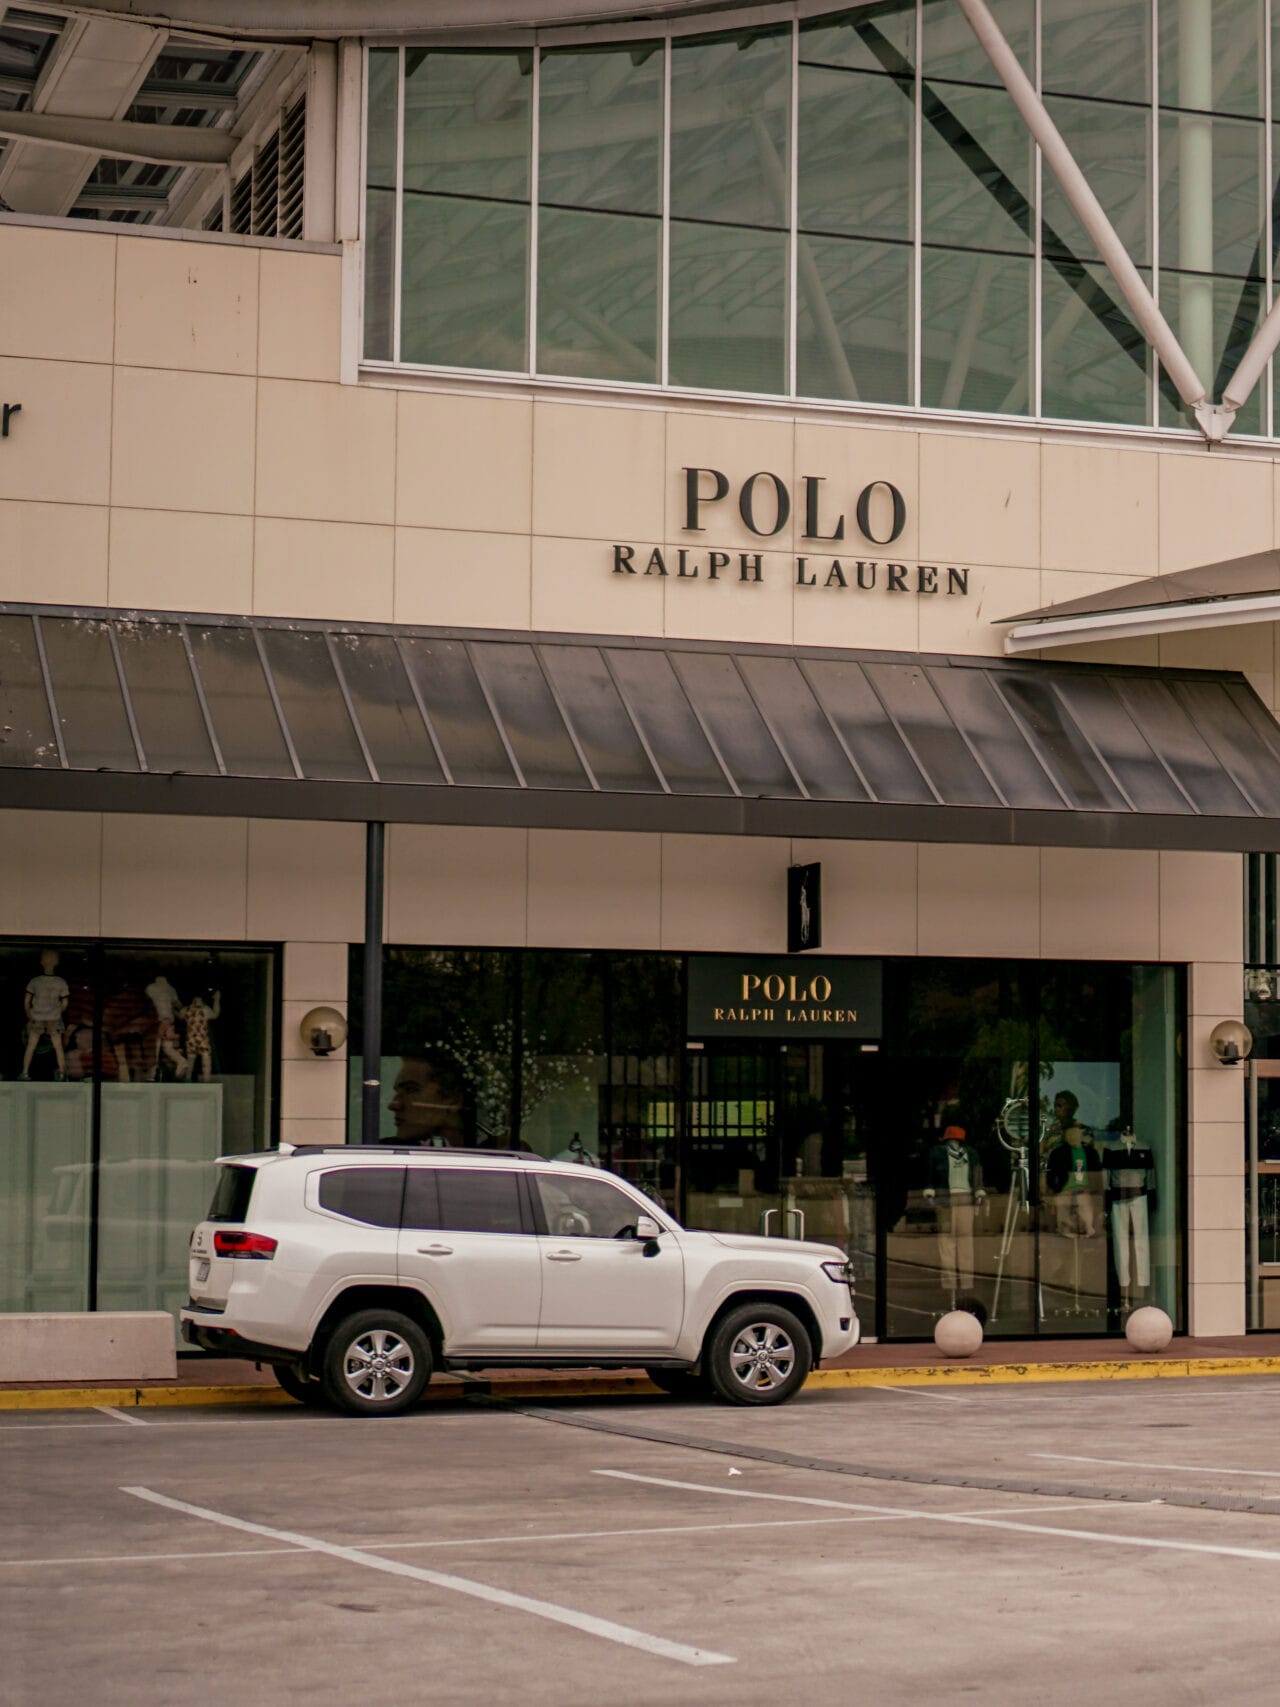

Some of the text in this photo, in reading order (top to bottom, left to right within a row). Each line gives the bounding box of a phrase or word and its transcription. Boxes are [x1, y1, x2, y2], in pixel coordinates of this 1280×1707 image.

[682, 467, 907, 545] POLO
[612, 545, 970, 596] RALPH LAUREN
[741, 974, 832, 1002] POLO
[714, 1008, 858, 1022] RALPH LAUREN
